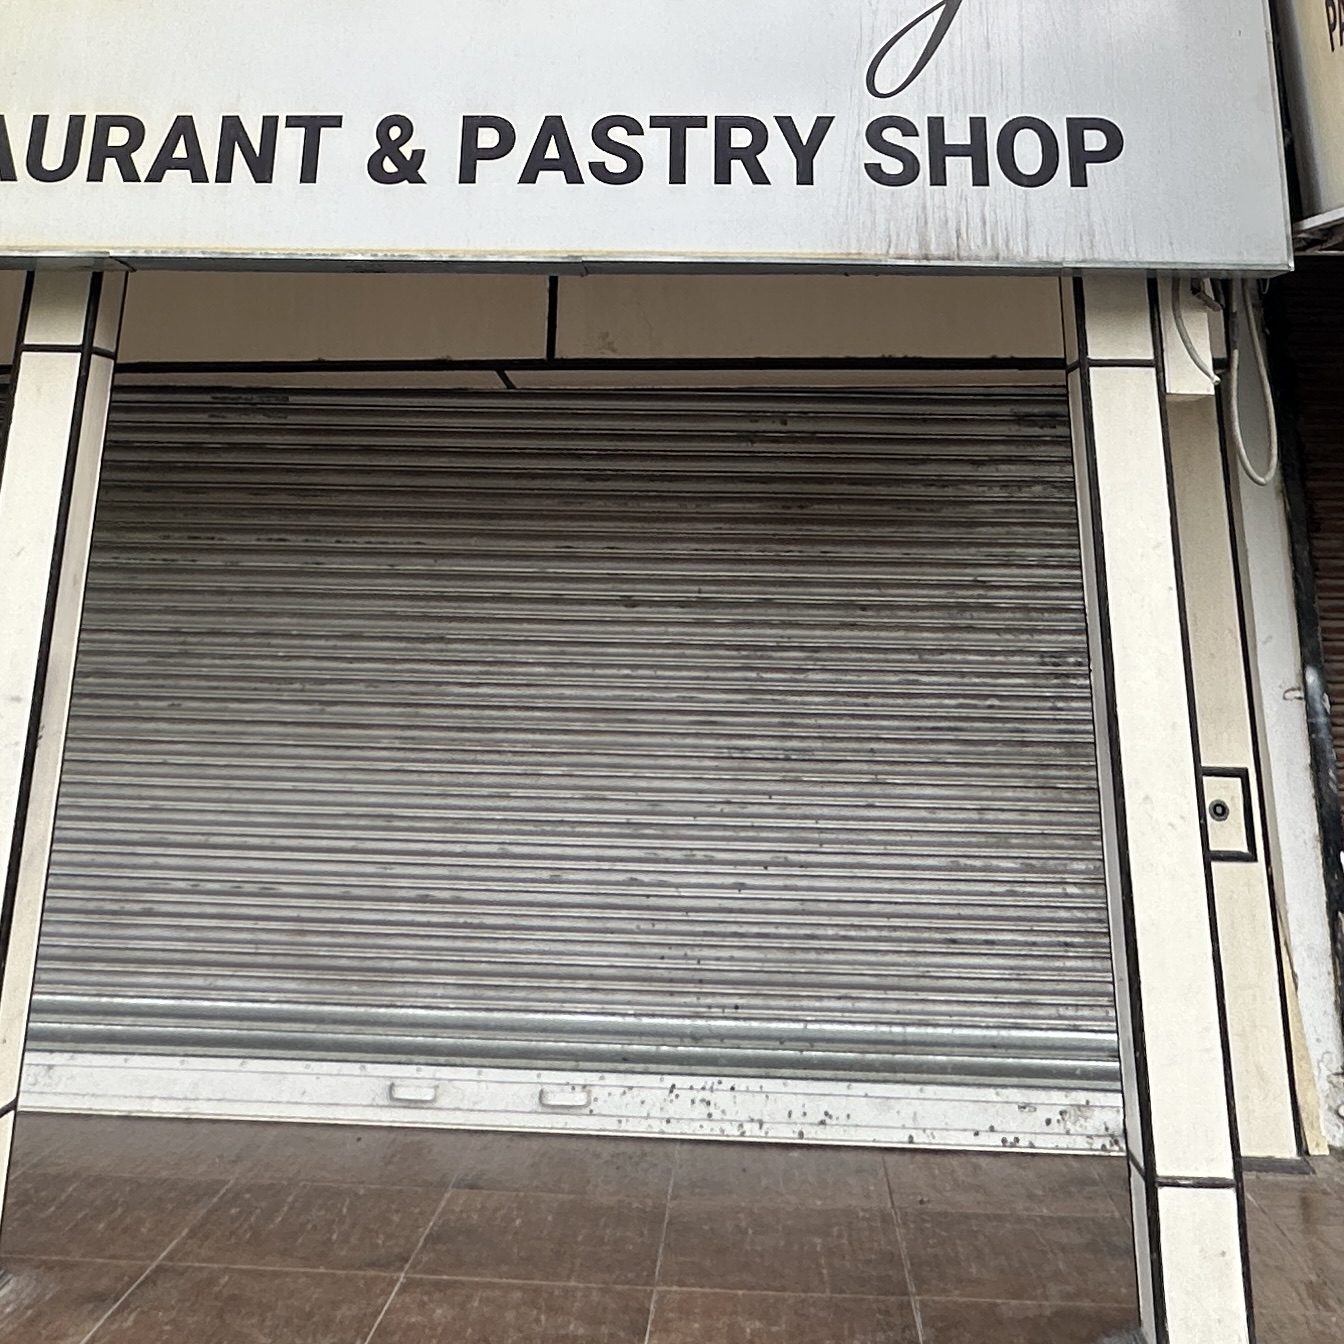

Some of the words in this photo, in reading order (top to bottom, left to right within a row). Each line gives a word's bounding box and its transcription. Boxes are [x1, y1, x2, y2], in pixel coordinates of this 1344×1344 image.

[366, 113, 428, 186] &
[458, 114, 835, 187] PASTRY
[863, 114, 1125, 188] SHOP
